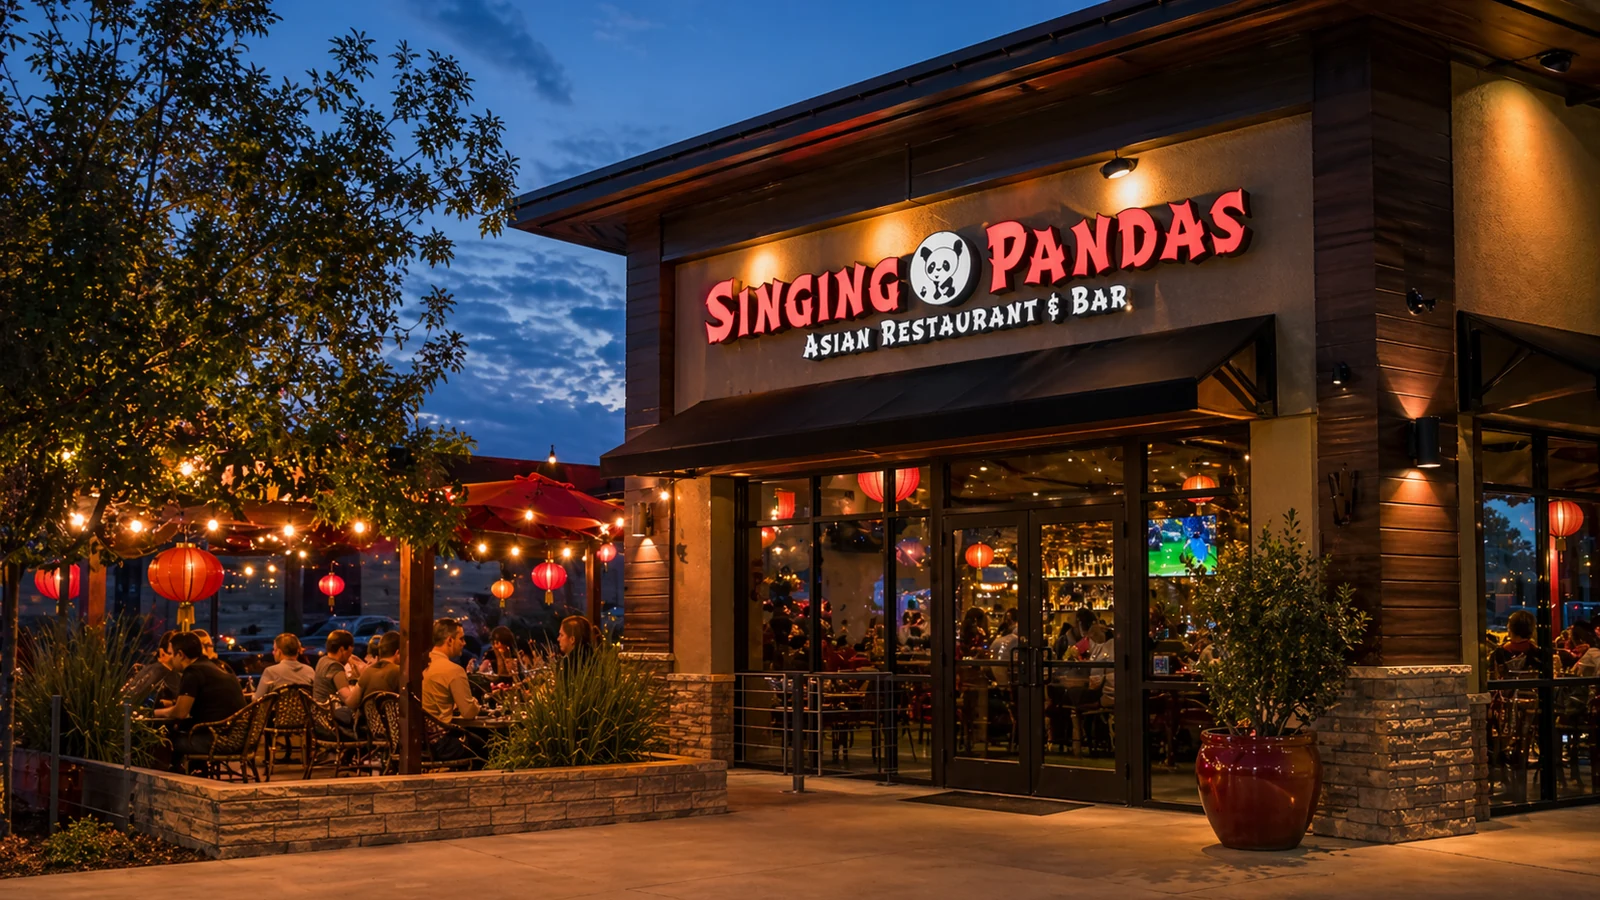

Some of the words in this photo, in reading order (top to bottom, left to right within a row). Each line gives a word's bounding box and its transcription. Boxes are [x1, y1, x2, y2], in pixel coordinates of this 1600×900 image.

[705, 257, 900, 344] SINGING
[985, 188, 1246, 294] PANDAS
[802, 327, 871, 359] ASIAN
[880, 299, 1040, 347] RESTAURANT
[1071, 284, 1128, 316] BAR
